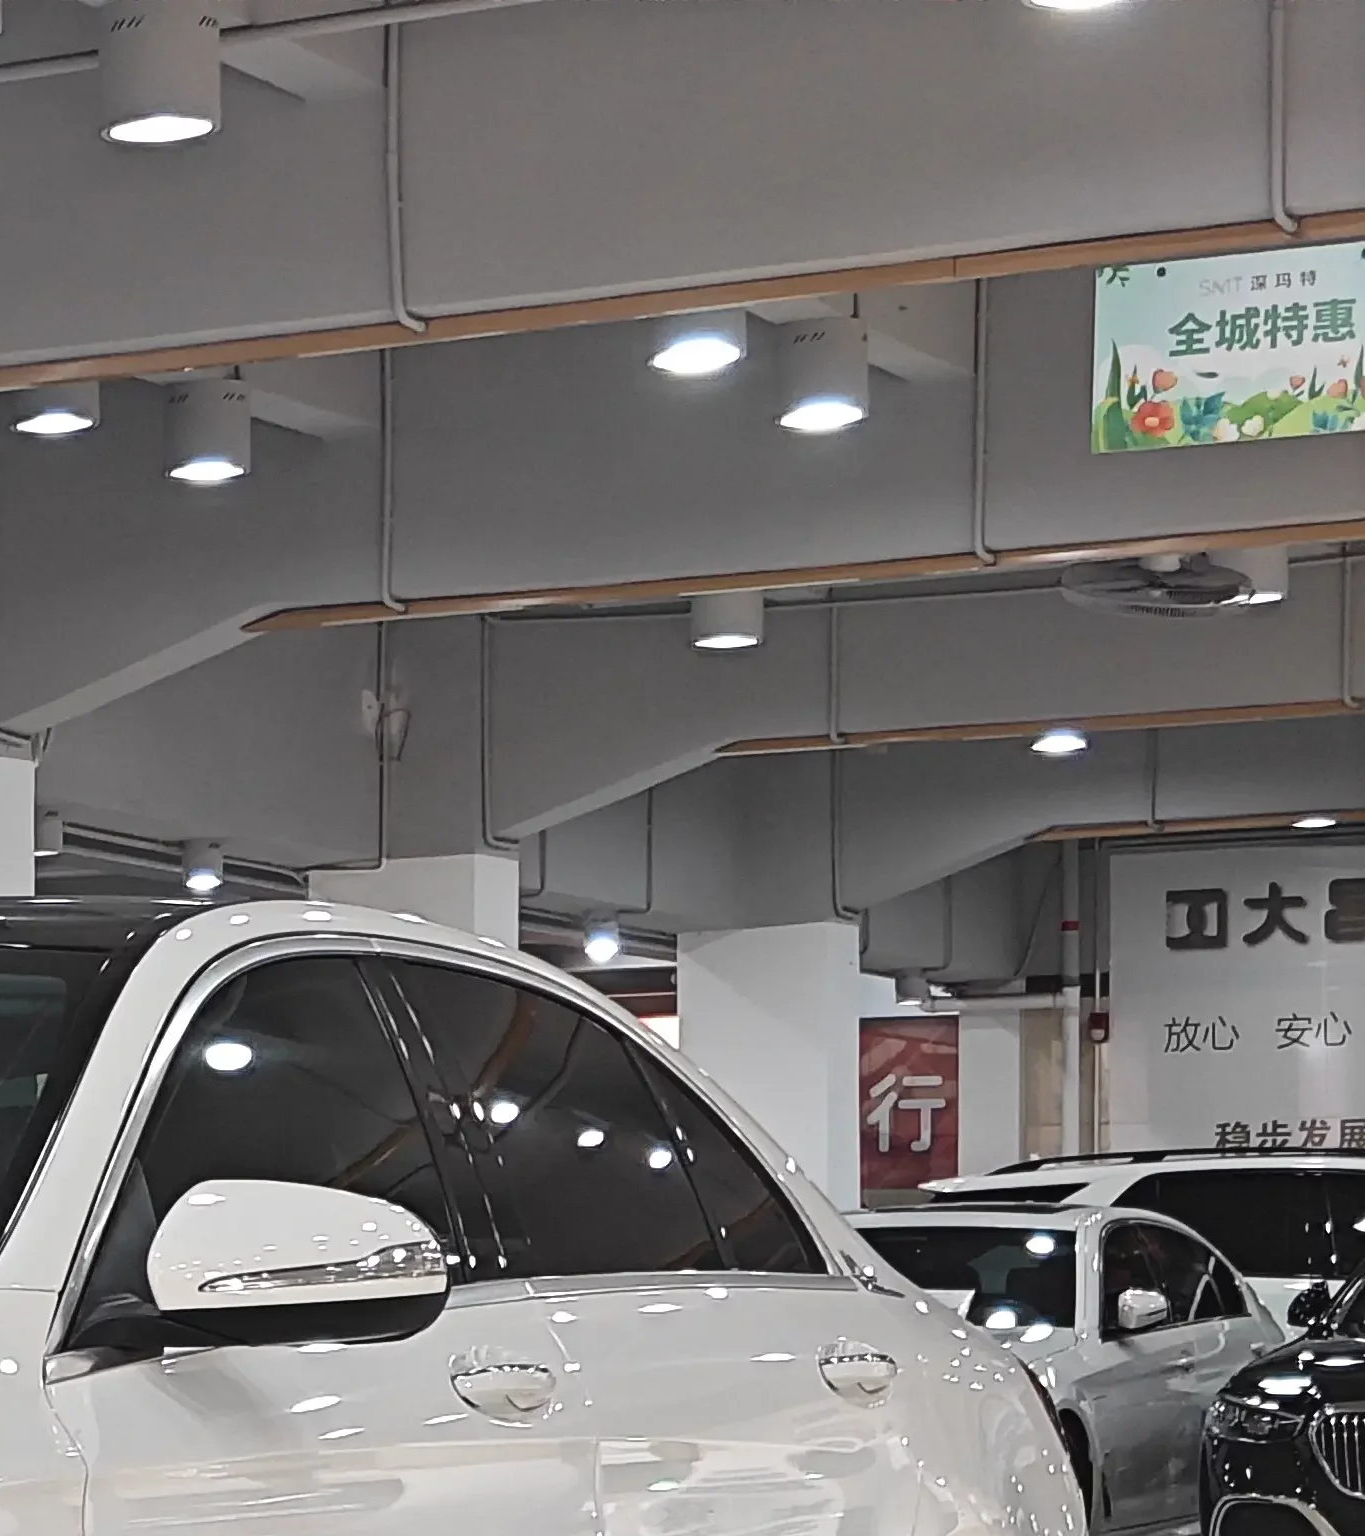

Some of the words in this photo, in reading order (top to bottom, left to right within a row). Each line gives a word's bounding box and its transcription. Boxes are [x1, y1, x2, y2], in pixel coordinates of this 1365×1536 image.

[1168, 298, 1356, 357] 全城特惠
[1163, 1015, 1239, 1053] 放心
[1275, 1011, 1352, 1049] 安心
[867, 1073, 946, 1152] 行
